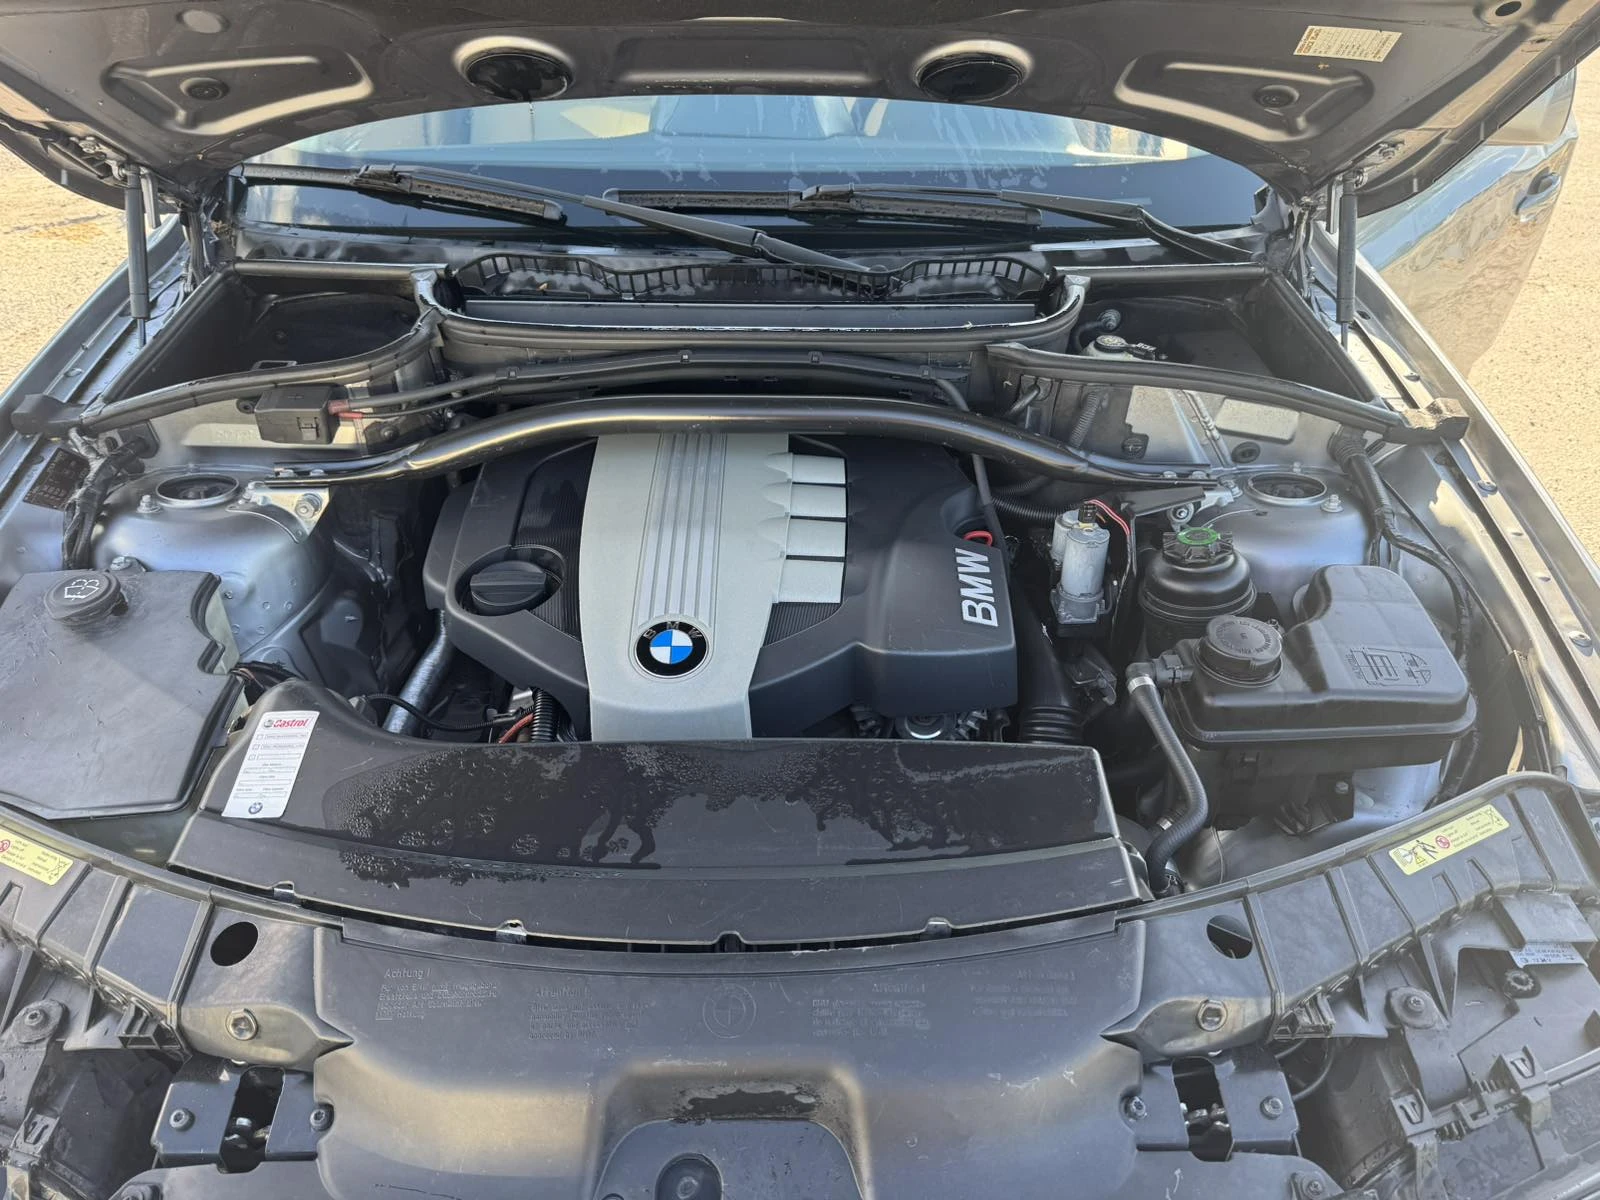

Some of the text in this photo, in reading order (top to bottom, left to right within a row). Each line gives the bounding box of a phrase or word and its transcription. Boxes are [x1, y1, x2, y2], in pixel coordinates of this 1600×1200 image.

[954, 547, 999, 627] BMW
[642, 620, 703, 640] BMW
[272, 718, 310, 728] Castrol
